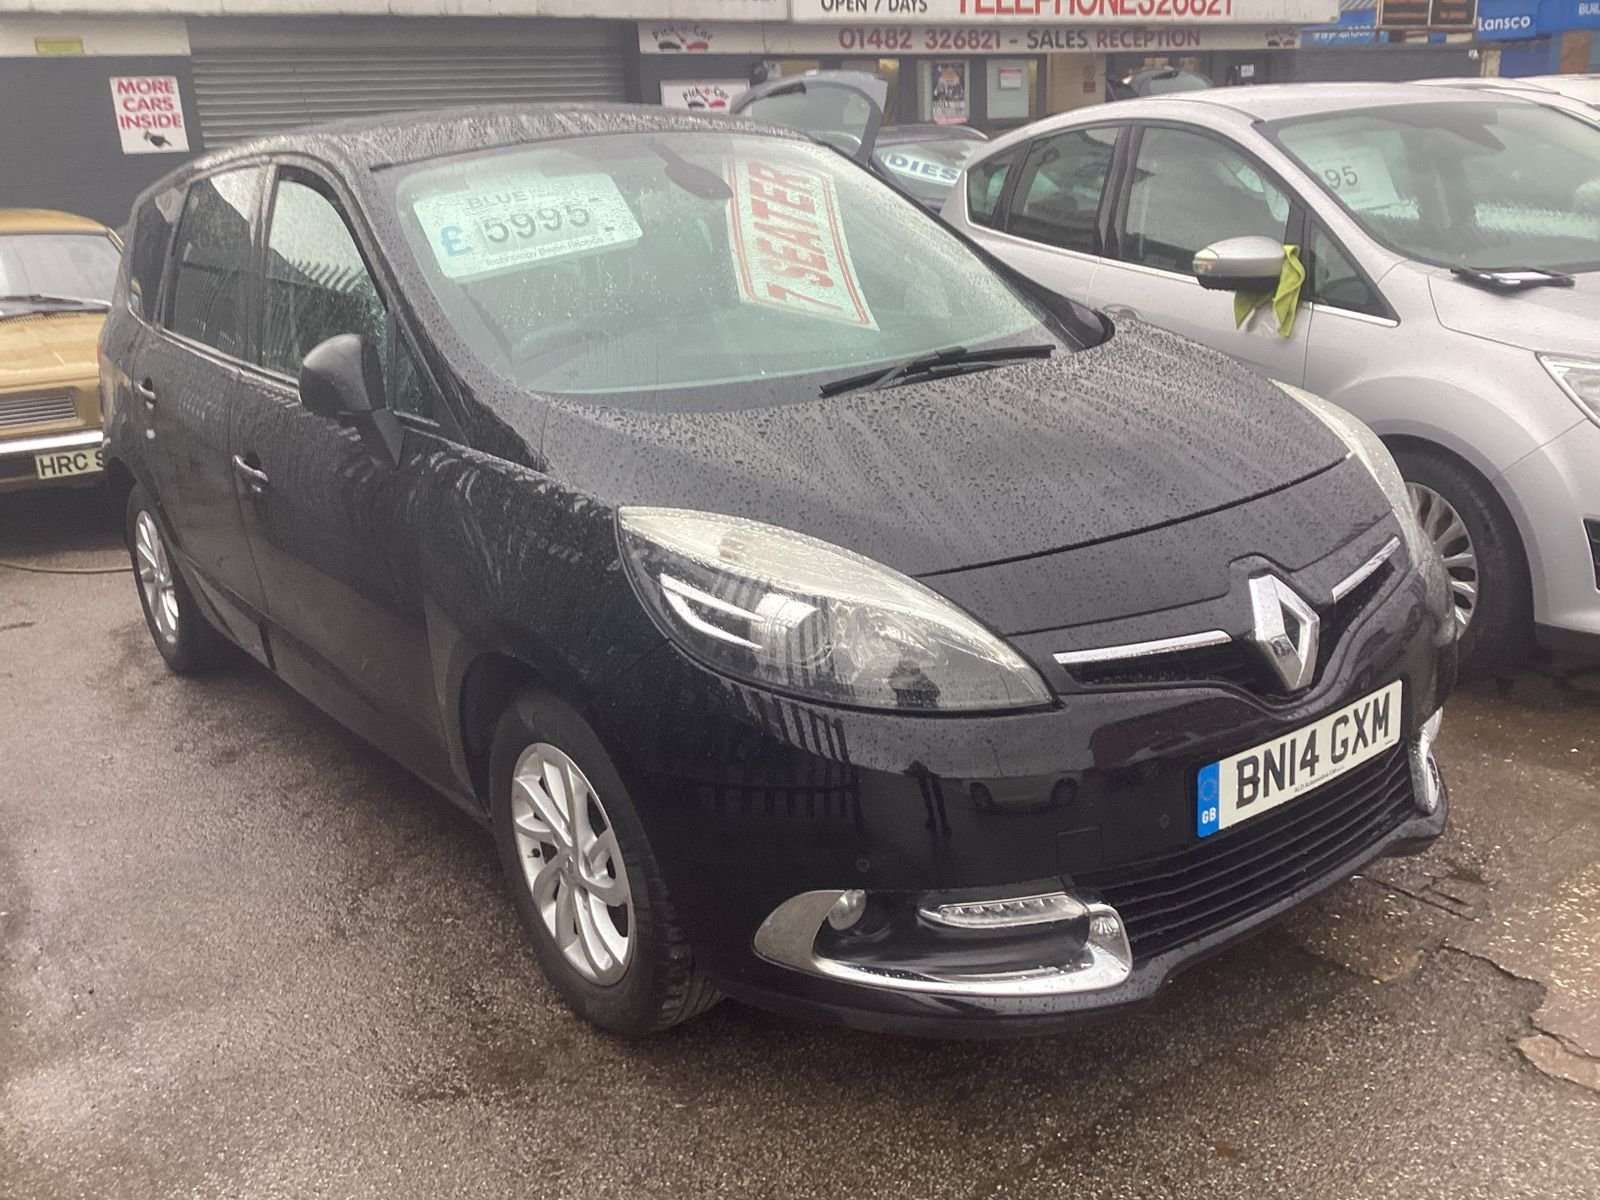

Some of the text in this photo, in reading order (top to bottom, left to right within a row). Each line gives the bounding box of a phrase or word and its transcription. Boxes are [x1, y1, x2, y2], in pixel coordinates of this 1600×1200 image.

[820, 0, 867, 13] OPEN
[888, 0, 928, 13] DAYS
[1478, 16, 1531, 32] Lansco
[838, 28, 912, 49] 01482
[925, 27, 1001, 49] 326821
[1026, 29, 1088, 49] SALES
[1096, 28, 1200, 48] RECEPTION
[116, 79, 175, 95] MORE
[122, 97, 174, 112] CARS
[119, 113, 182, 129] INSIDE
[889, 154, 957, 180] DIES
[467, 190, 528, 211] BLUE
[484, 204, 590, 243] 5995
[747, 159, 842, 311] 7 SEATER
[39, 452, 88, 477] HRC
[1236, 692, 1390, 810] BN14 GXM
[1202, 807, 1217, 824] GB
